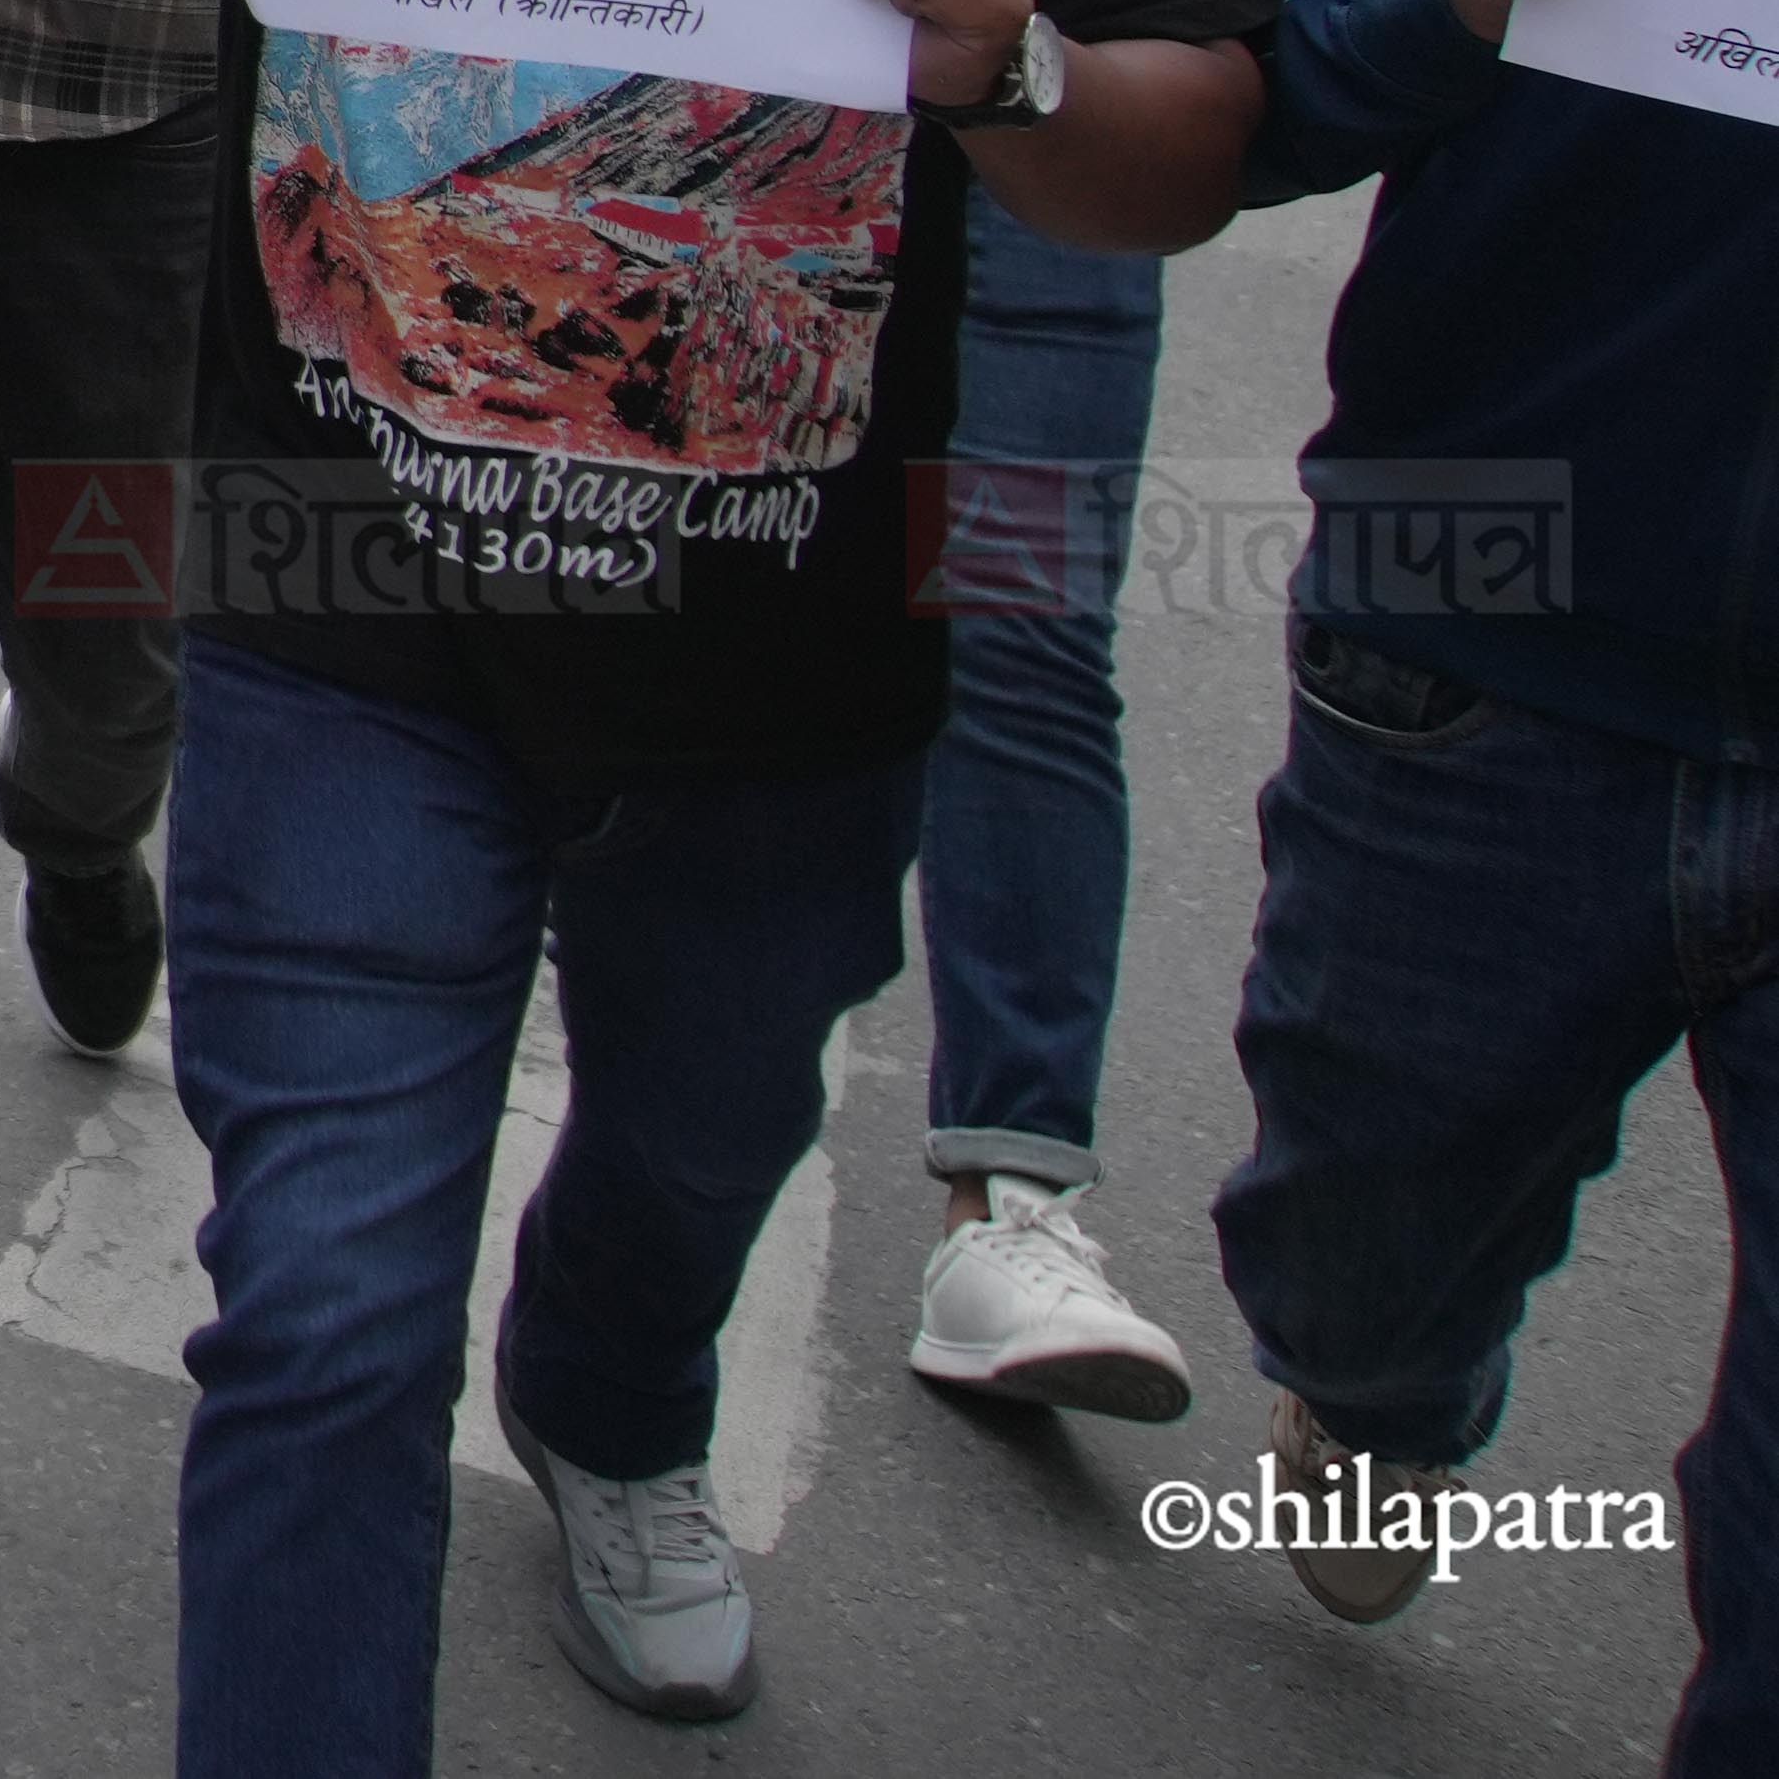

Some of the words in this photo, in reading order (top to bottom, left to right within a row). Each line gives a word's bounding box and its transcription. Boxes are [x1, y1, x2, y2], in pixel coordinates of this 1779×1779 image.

[391, 487, 657, 588] 4130m)
[530, 453, 673, 533] Base
[677, 472, 821, 571] Camp
